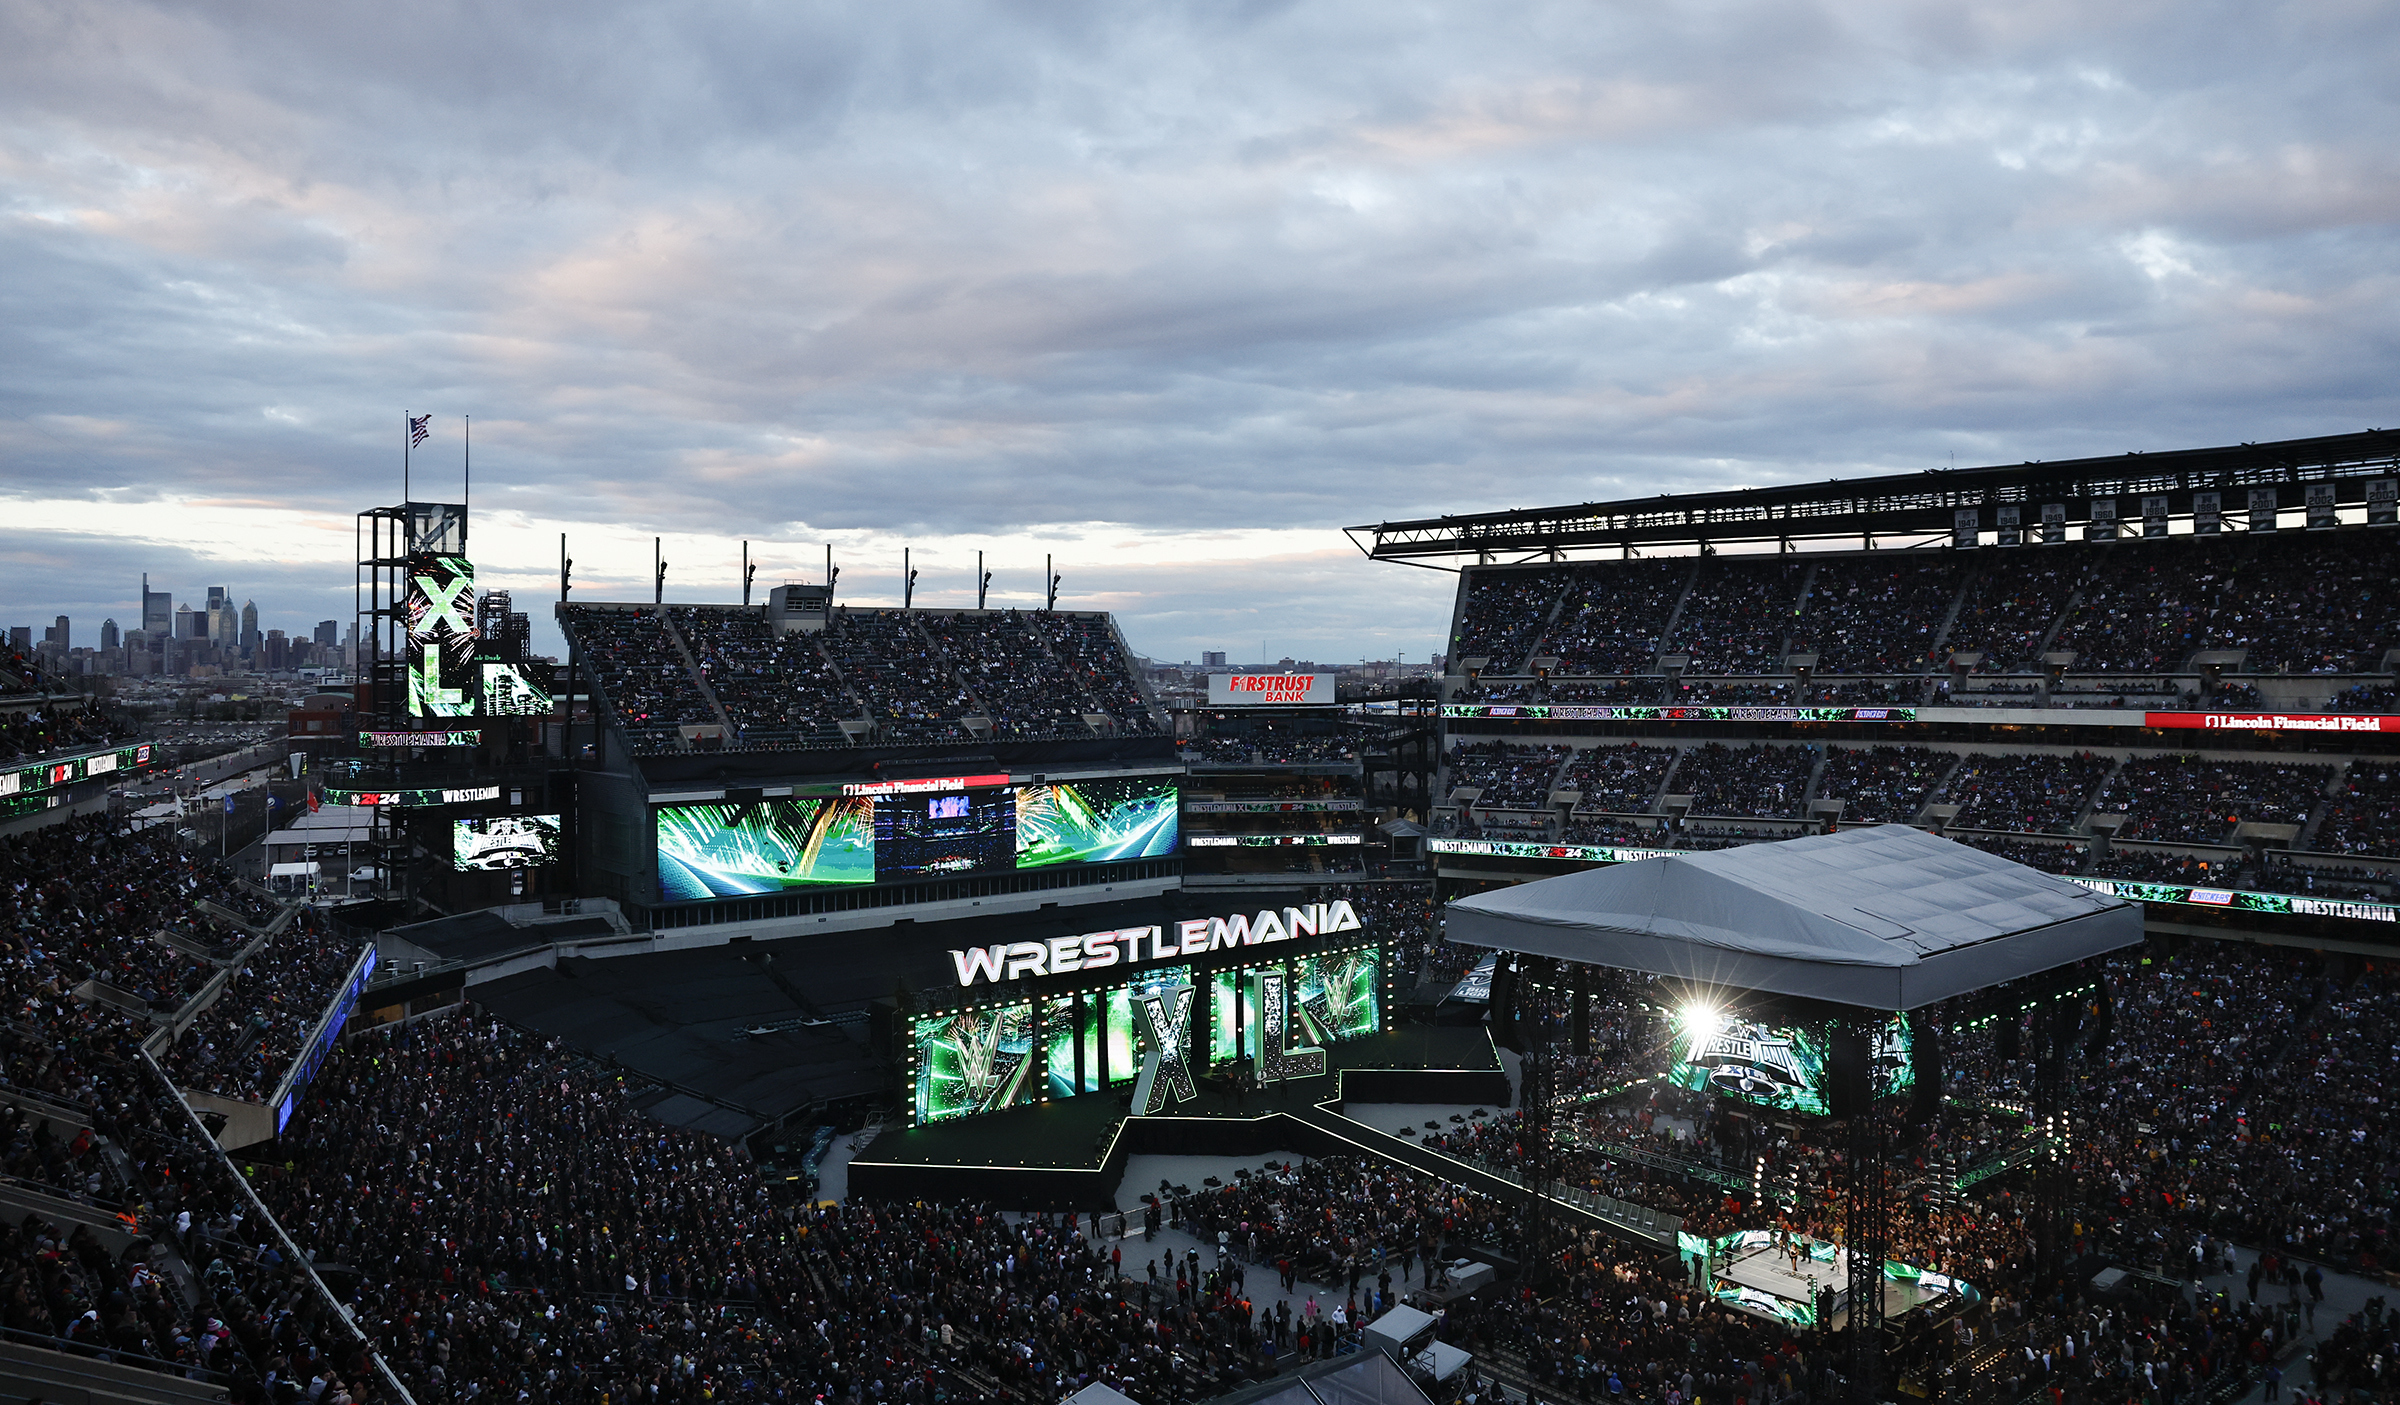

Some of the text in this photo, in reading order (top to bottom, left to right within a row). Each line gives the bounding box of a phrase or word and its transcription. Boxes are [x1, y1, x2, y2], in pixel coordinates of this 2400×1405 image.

[2309, 495, 2334, 505] 2002
[2369, 490, 2396, 500] 2003
[2251, 500, 2274, 509] 2001
[2094, 510, 2113, 519] 1960
[2146, 507, 2165, 516] 1980
[2000, 516, 2018, 525] 1948
[2045, 513, 2063, 522] 1949
[1957, 519, 1976, 528] 1947
[1265, 691, 1305, 702] BANK
[1443, 706, 1458, 717] XL
[1611, 708, 1629, 719] XL
[1731, 709, 1798, 720] WRESTLEMANIA
[1798, 709, 1817, 720] XL
[2221, 715, 2381, 731] Lincoln Financial Field
[447, 732, 465, 746] XL
[854, 778, 965, 796] Lincoln Financial Field
[361, 793, 400, 805] 2K24
[442, 785, 500, 803] WRESTLEMANIA
[1431, 840, 1492, 854] WRESTLEMANIA
[2115, 883, 2139, 898] XL
[2191, 891, 2230, 903] SNICKERS
[2291, 899, 2396, 923] WRESTLEMANIA
[947, 900, 1362, 987] WRESTLEMANIA
